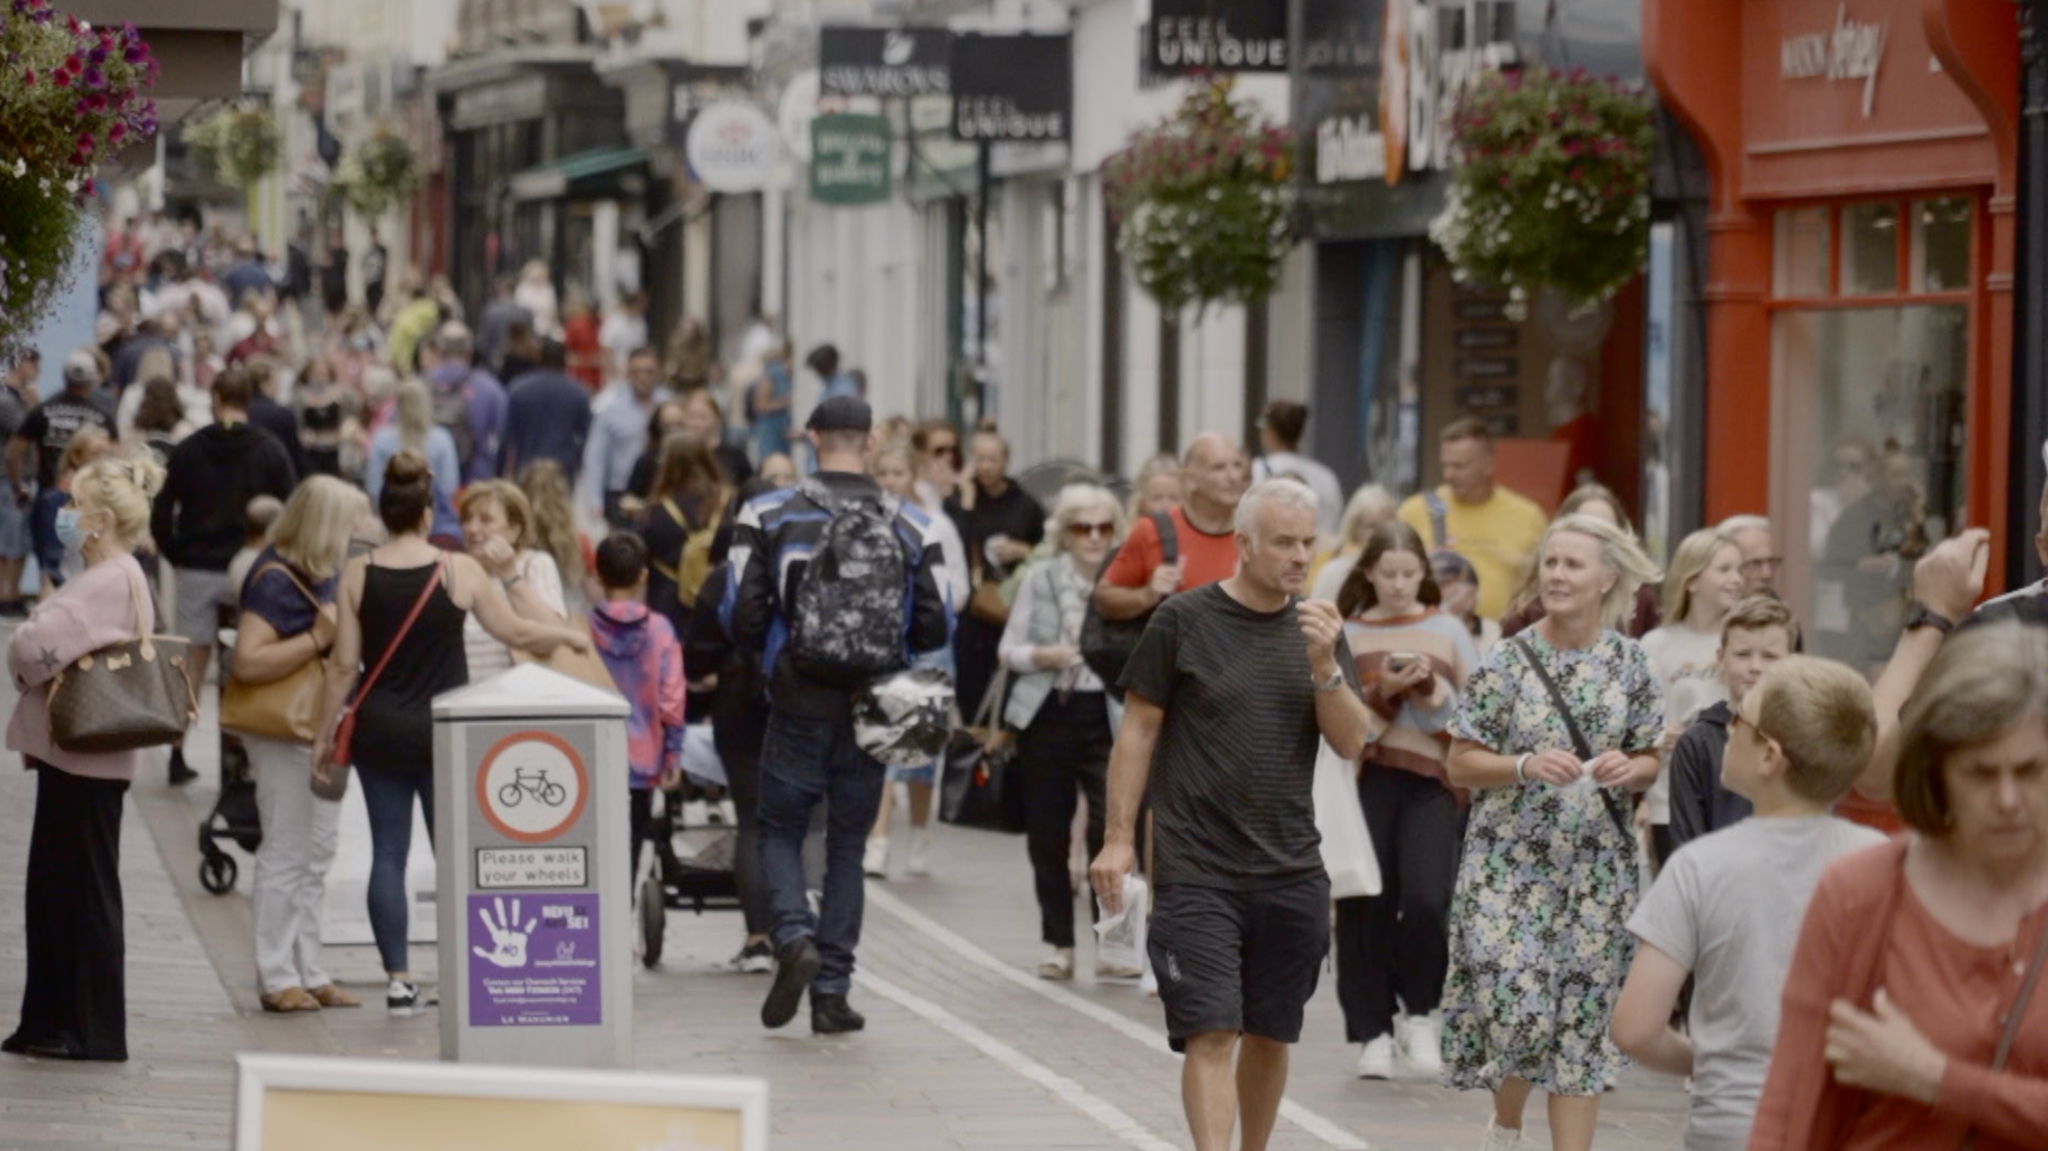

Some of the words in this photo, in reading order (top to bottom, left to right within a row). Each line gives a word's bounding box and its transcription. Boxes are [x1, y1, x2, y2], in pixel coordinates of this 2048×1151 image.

[1159, 16, 1227, 40] FEEL
[1158, 38, 1286, 66] UNIQUE
[958, 113, 1063, 138] UNIQUE
[482, 851, 536, 864] Please
[543, 850, 580, 863] walk
[484, 870, 517, 884] your
[525, 867, 580, 881] wheels
